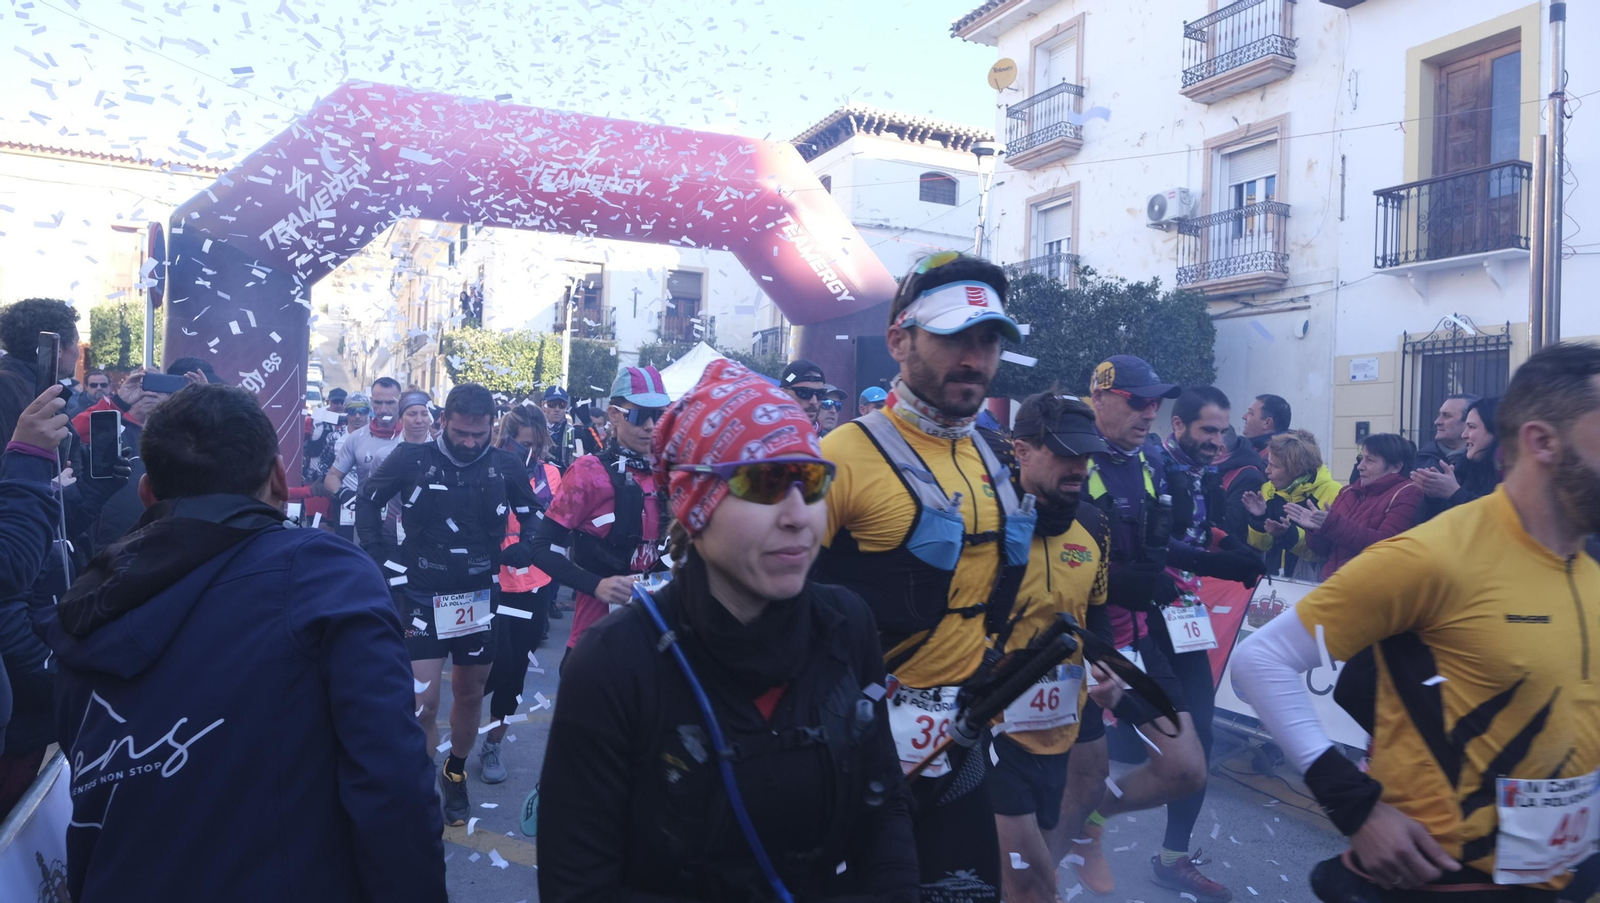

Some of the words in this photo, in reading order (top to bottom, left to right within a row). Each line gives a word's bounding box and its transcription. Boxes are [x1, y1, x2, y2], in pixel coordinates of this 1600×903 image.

[776, 212, 855, 301] TEAMERGY
[235, 352, 282, 394] gy.es
[455, 606, 474, 625] 21
[1183, 621, 1201, 639] 16
[1030, 687, 1060, 712] 46
[911, 715, 950, 750] 38
[72, 779, 97, 796] ENTOS
[100, 771, 124, 784] NON
[129, 761, 163, 777] STOP
